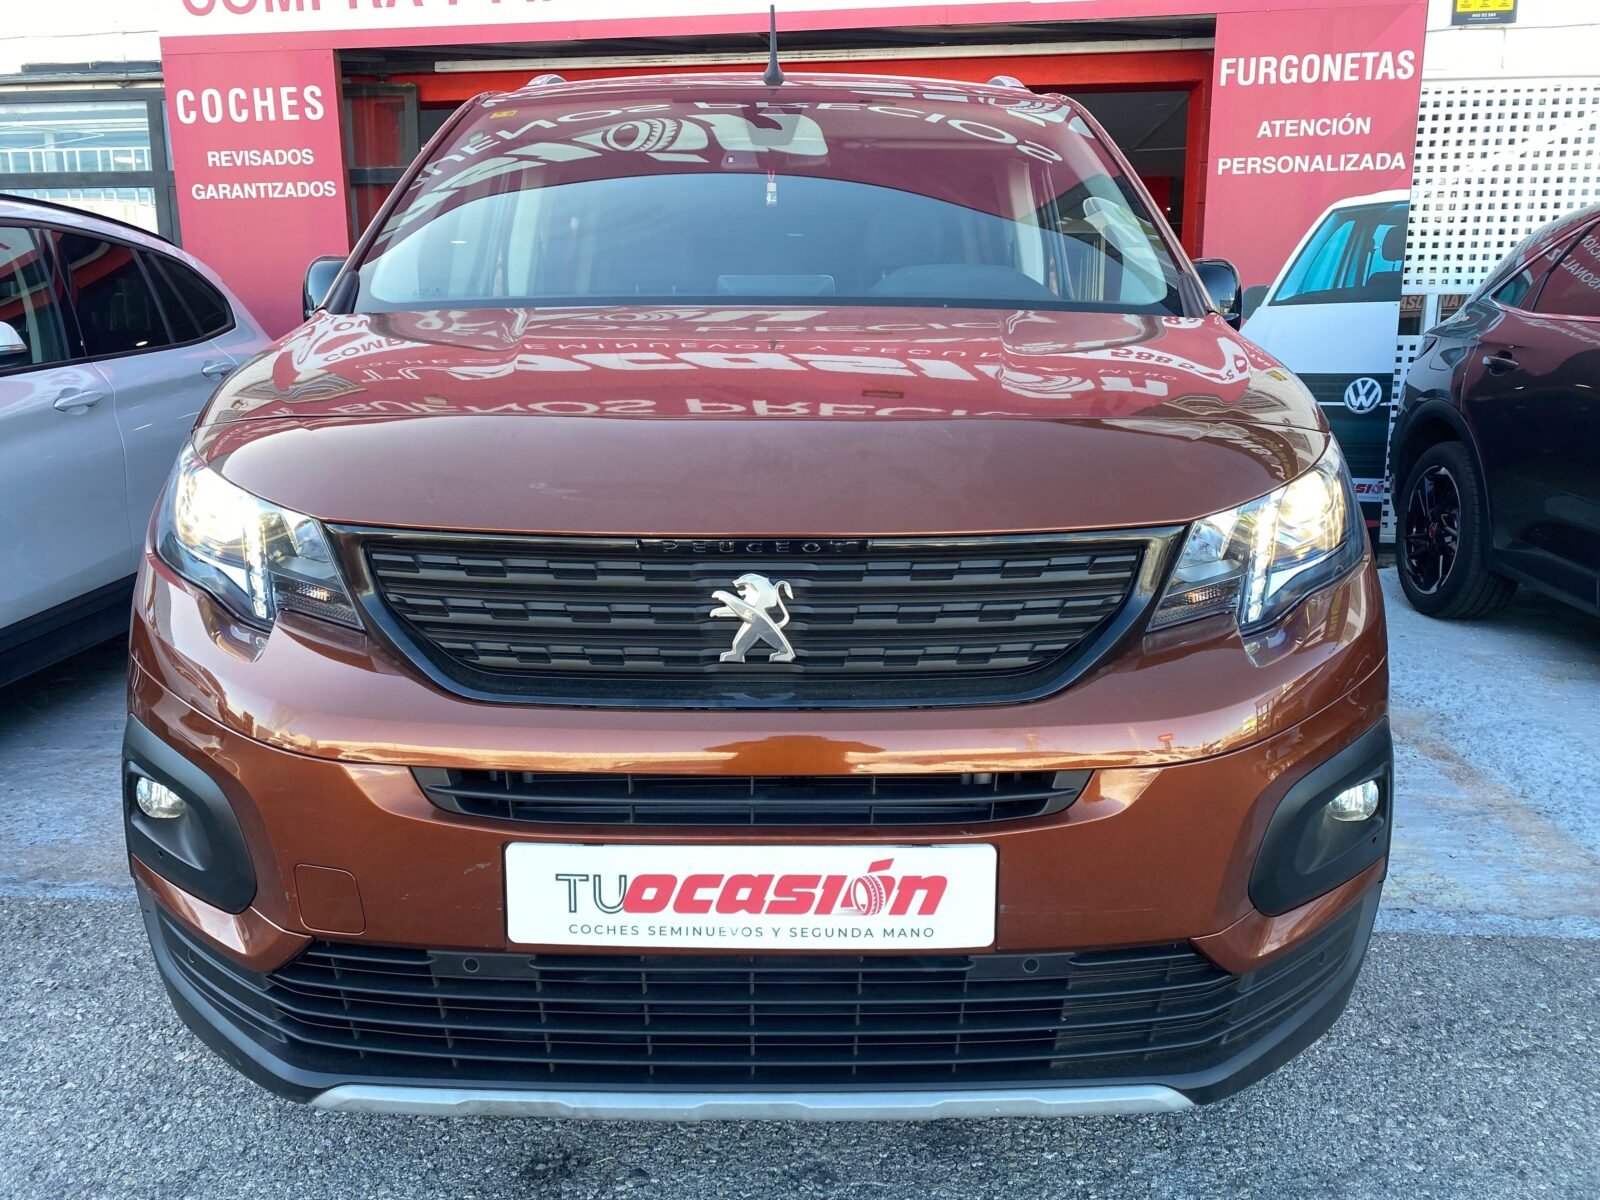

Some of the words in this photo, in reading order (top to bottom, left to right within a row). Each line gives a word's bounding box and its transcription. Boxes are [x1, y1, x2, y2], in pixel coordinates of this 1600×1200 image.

[1219, 49, 1416, 87] FURGONETAS
[176, 84, 325, 125] COCHES
[1256, 112, 1372, 139] ATENCIÓN
[207, 148, 315, 168] REVISADOS
[1217, 152, 1407, 176] PERSONALIZADA
[191, 180, 337, 200] GARANTIZADOS
[662, 540, 848, 554] PEUGEOT
[568, 923, 640, 937] COCHES
[647, 925, 764, 939] SEMINUEVOS
[771, 926, 780, 938] Y
[789, 926, 875, 939] SEGUNDA
[882, 926, 936, 939] MANO
